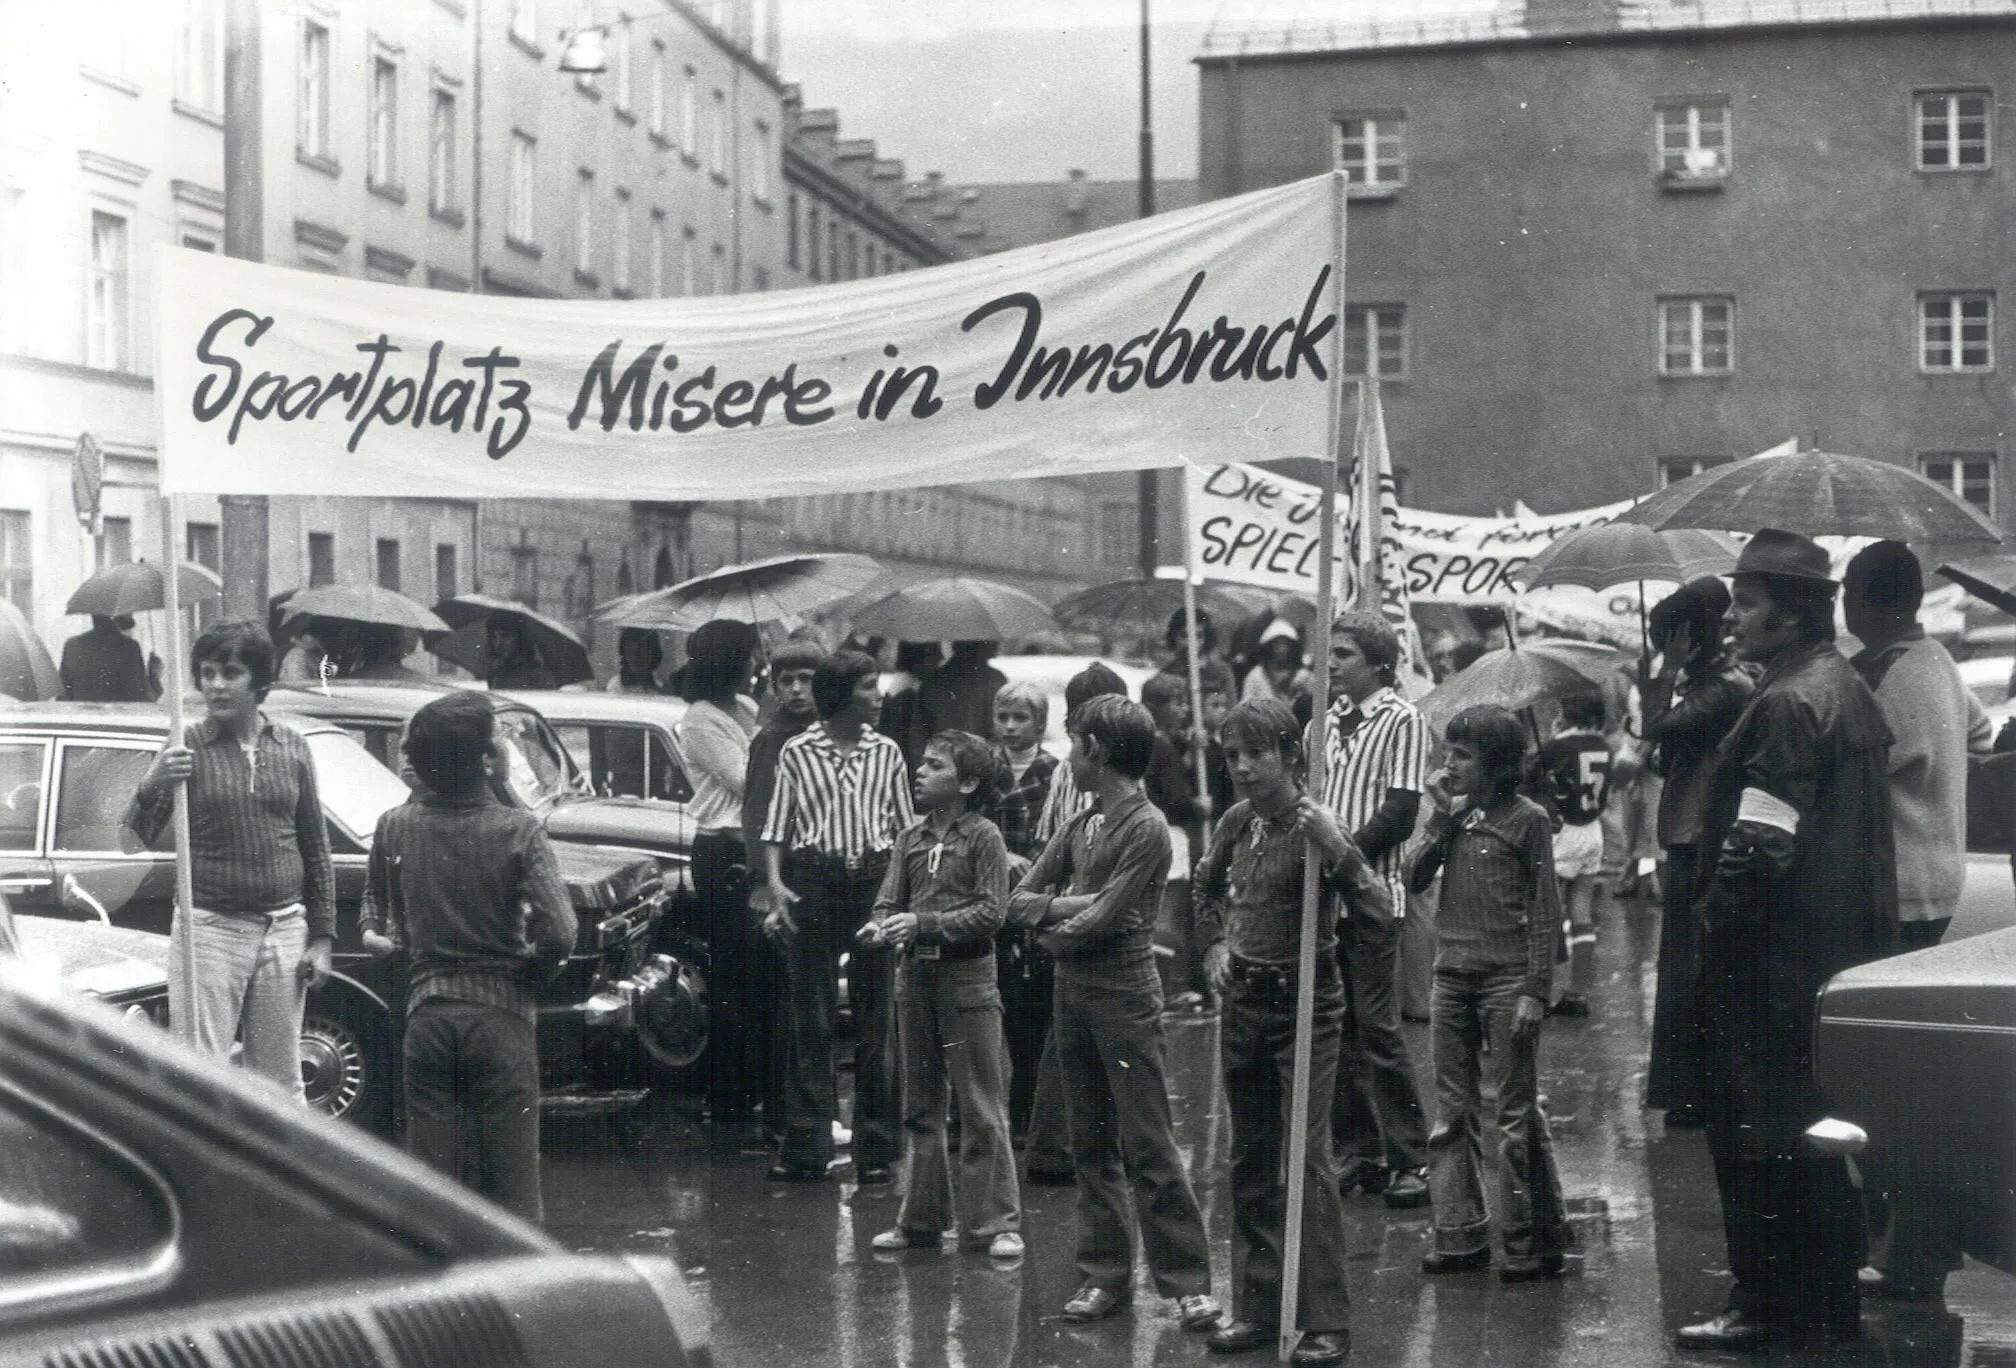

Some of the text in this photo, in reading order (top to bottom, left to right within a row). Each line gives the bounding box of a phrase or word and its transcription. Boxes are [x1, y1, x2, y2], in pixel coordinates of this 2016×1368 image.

[193, 263, 1338, 460] Sportplatz Misere in Innsbruck
[1204, 464, 1284, 509] Die
[1578, 751, 1610, 812] 5
